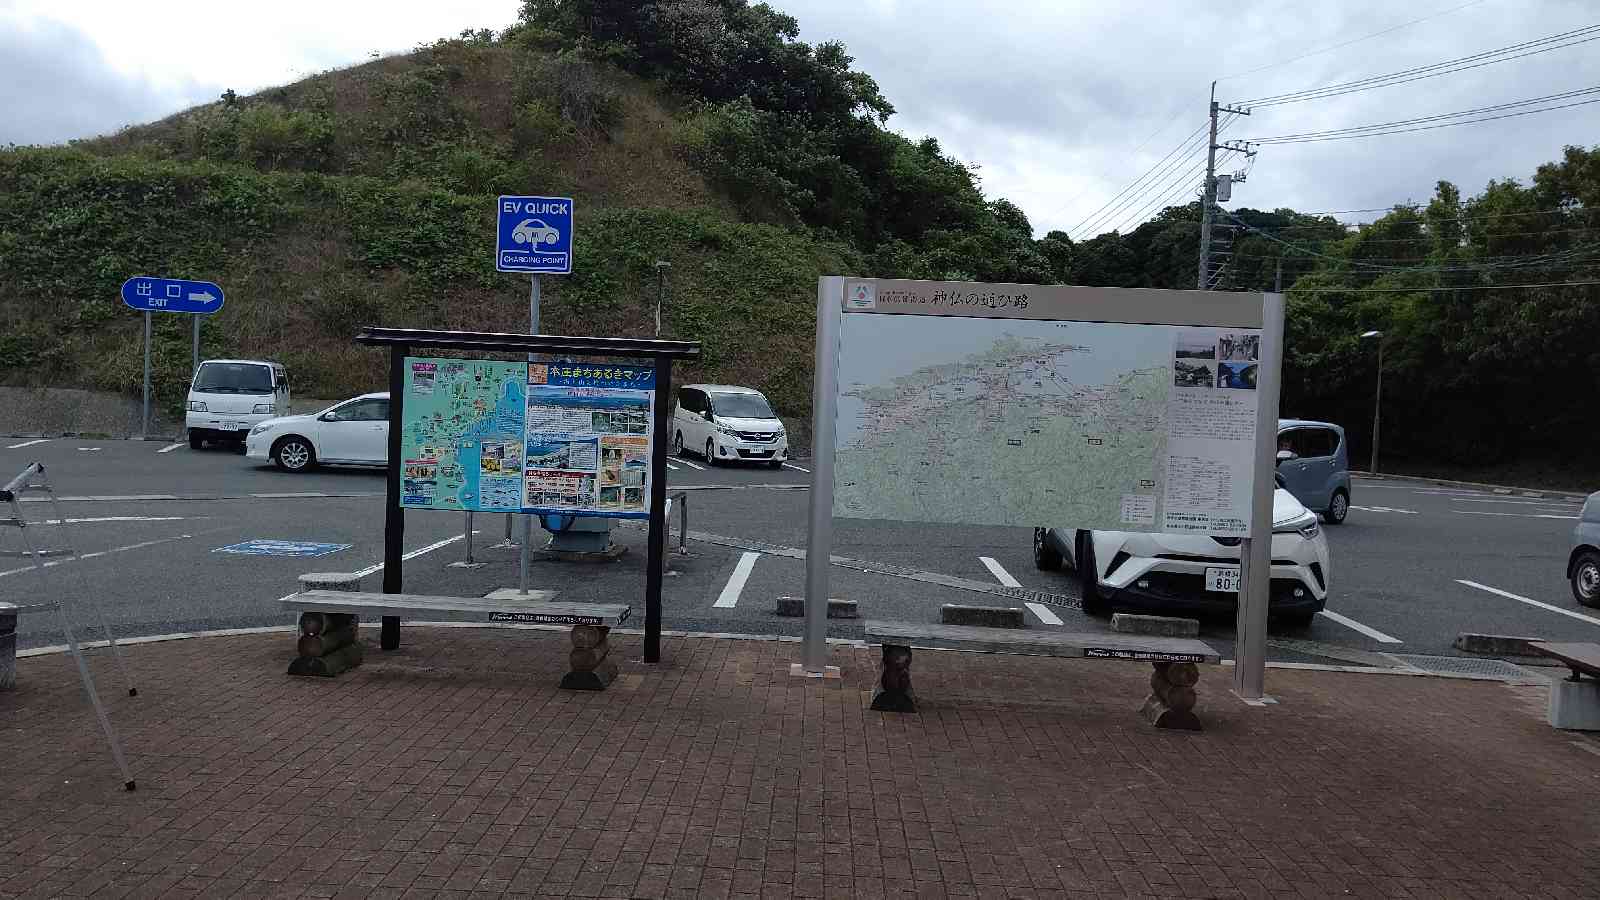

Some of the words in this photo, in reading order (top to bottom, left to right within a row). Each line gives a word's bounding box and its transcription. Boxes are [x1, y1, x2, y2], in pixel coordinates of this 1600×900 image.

[503, 201, 522, 214] EV
[525, 202, 568, 215] QUICK
[503, 256, 541, 264] CHARGING
[136, 281, 181, 298] 出口
[148, 297, 168, 307] EXIT
[1216, 578, 1241, 591] 80-0
